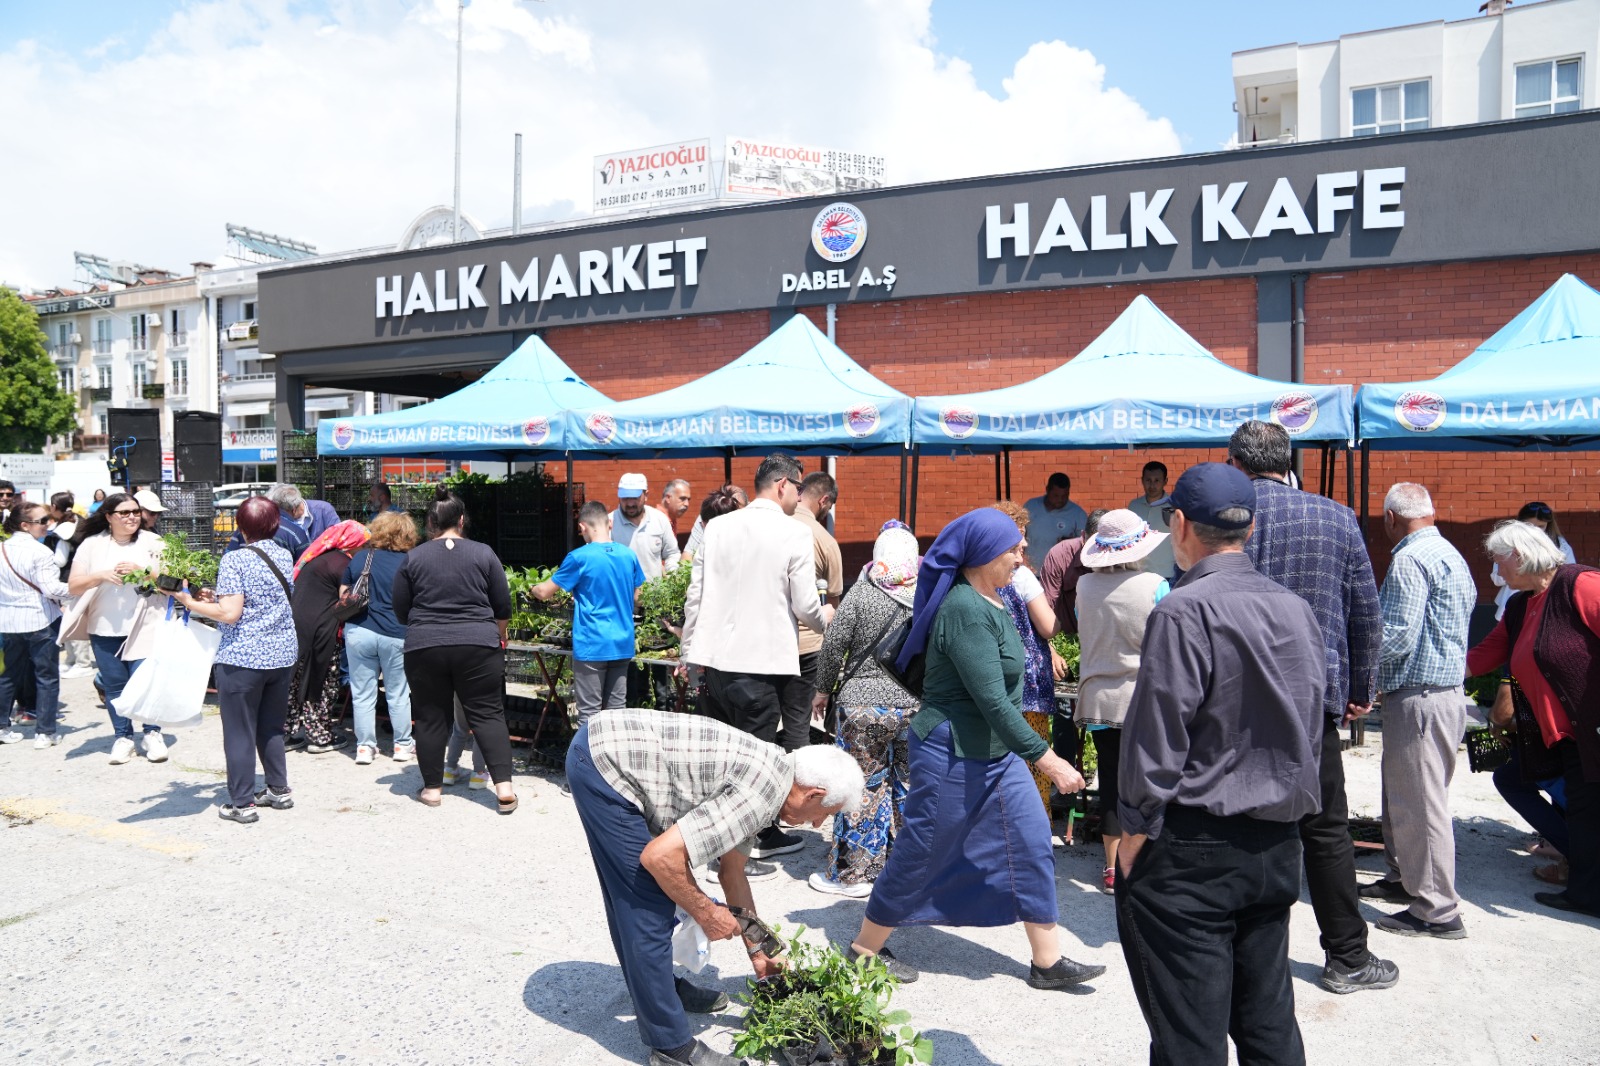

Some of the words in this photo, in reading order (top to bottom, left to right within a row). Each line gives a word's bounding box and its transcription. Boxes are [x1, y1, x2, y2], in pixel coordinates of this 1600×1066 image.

[619, 145, 706, 174] YAZICIOĞLU
[744, 143, 821, 163] YAZICIOĞLU
[838, 152, 851, 163] 534
[817, 208, 837, 228] DALAMAN
[985, 188, 1178, 259] HALK
[1202, 167, 1405, 242] KAFE
[376, 264, 489, 318] HALK
[501, 237, 706, 305] MARKET
[782, 269, 851, 293] DABEL
[857, 265, 897, 291] A.Ş
[625, 418, 714, 437] DALAMAN
[720, 411, 834, 434] BELEDİYESİ
[990, 410, 1104, 432] DALAMAN
[1113, 402, 1258, 430] BELEDİYESİ
[360, 427, 426, 444] DALAMAN
[430, 422, 515, 442] BELEDİYESİ
